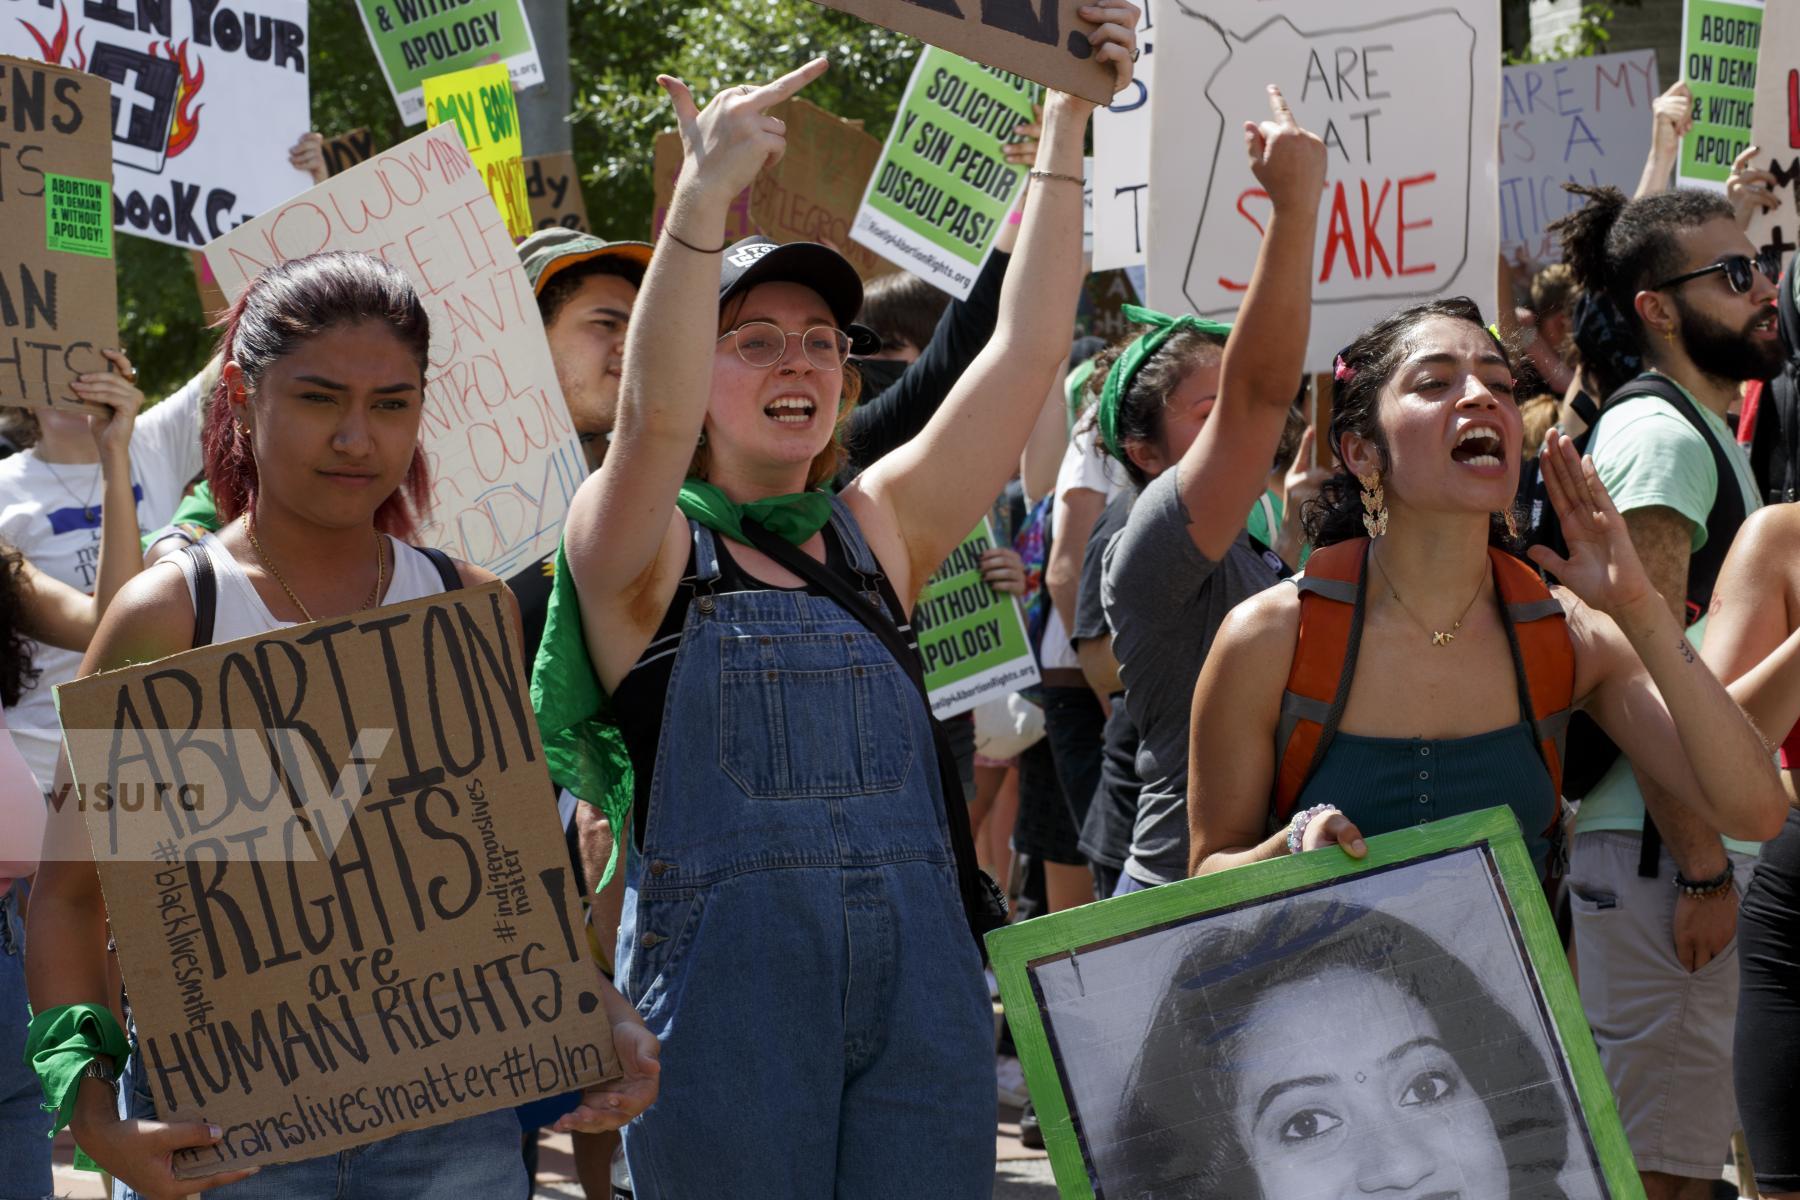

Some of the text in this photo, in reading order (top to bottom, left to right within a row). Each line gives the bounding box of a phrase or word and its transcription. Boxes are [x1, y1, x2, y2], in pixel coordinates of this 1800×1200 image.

[189, 0, 305, 74] YOUR
[400, 11, 502, 70] APOLOGY
[1689, 54, 1712, 82] ON
[1301, 44, 1394, 103] ARE
[1503, 56, 1656, 117] ARE MY
[898, 110, 1017, 202] Y SIN PEDIR
[1324, 108, 1382, 164] AT
[1563, 115, 1604, 163] A
[52, 178, 102, 199] ABORTION
[53, 194, 101, 212] ON DEMAND
[61, 208, 101, 226] WITHOUT
[228, 202, 331, 282] NO
[329, 136, 471, 234] WOMAN
[876, 160, 995, 249] DISCULPAS!
[54, 221, 103, 243] APOLOGY!
[1218, 172, 1438, 291] SAKE
[421, 348, 534, 440] NTROL
[466, 388, 571, 483] OWN
[108, 592, 536, 856] ABORTION
[184, 786, 484, 980] RIGHTS
[501, 844, 532, 917] matter
[309, 947, 399, 1001] are
[147, 994, 370, 1112] HUMAN
